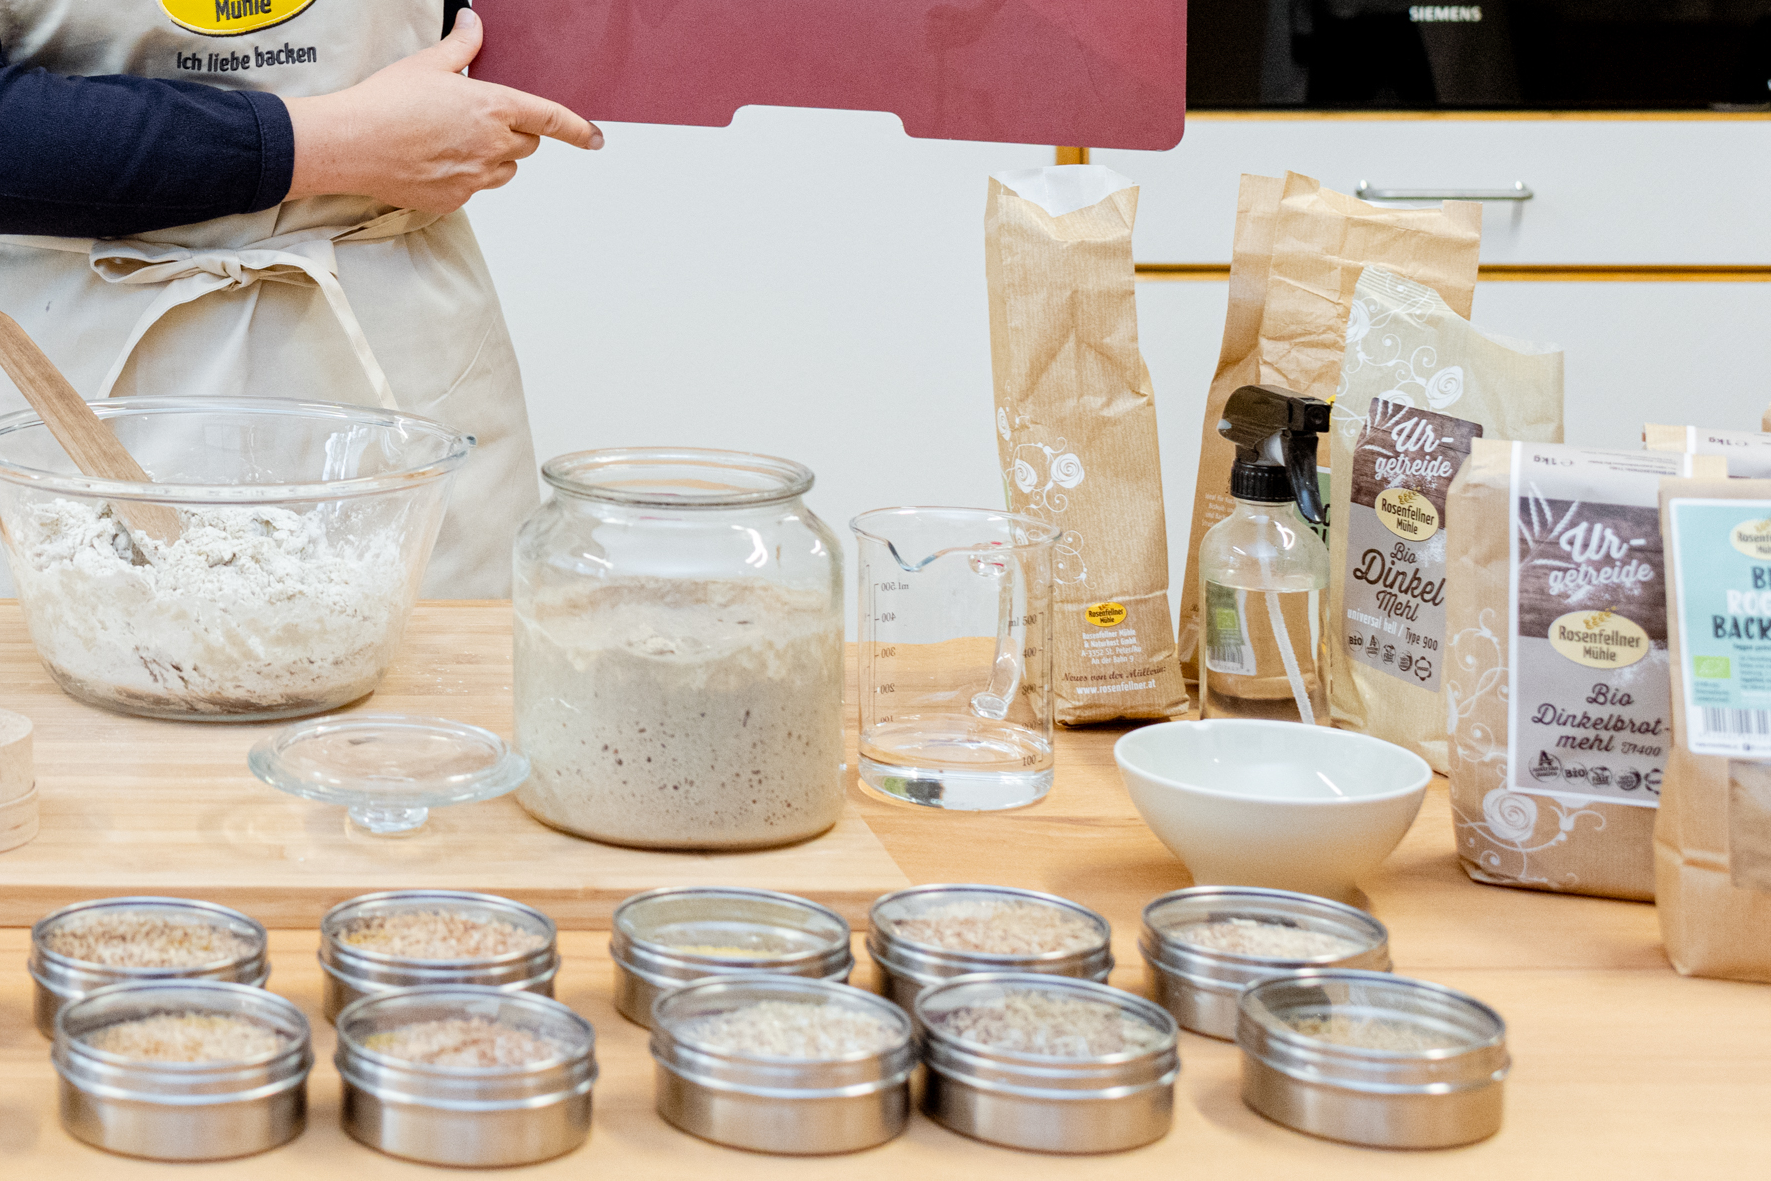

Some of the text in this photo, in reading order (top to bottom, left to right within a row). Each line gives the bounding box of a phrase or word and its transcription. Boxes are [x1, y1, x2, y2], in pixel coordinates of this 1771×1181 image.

[1408, 5, 1483, 22] SIEMENS
[177, 42, 317, 73] Ich liebe backen
[1391, 416, 1454, 453] Ur-
[1374, 453, 1453, 481] getreide
[1381, 498, 1435, 526] Rosenfellner
[1396, 517, 1419, 535] Mühle
[1389, 541, 1417, 564] Bio
[1559, 520, 1647, 563] Ur-
[1352, 548, 1447, 607] Dinkel
[1548, 559, 1655, 596] getreide
[1088, 608, 1124, 618] Rosenfellner
[1375, 590, 1420, 622] Mehl
[1347, 608, 1383, 630] universal
[1383, 617, 1398, 635] hell
[1405, 627, 1421, 645] Type
[1422, 636, 1438, 651] 900
[1558, 625, 1641, 649] Rosenfellner
[1582, 646, 1617, 662] Mühle
[1062, 672, 1088, 682] Neues
[1109, 670, 1124, 680] der
[1075, 678, 1157, 695] www.rosenfellner.at
[1585, 682, 1634, 706] Bio
[1531, 702, 1671, 736] Dinkelbrot-
[1555, 733, 1615, 752] mehl
